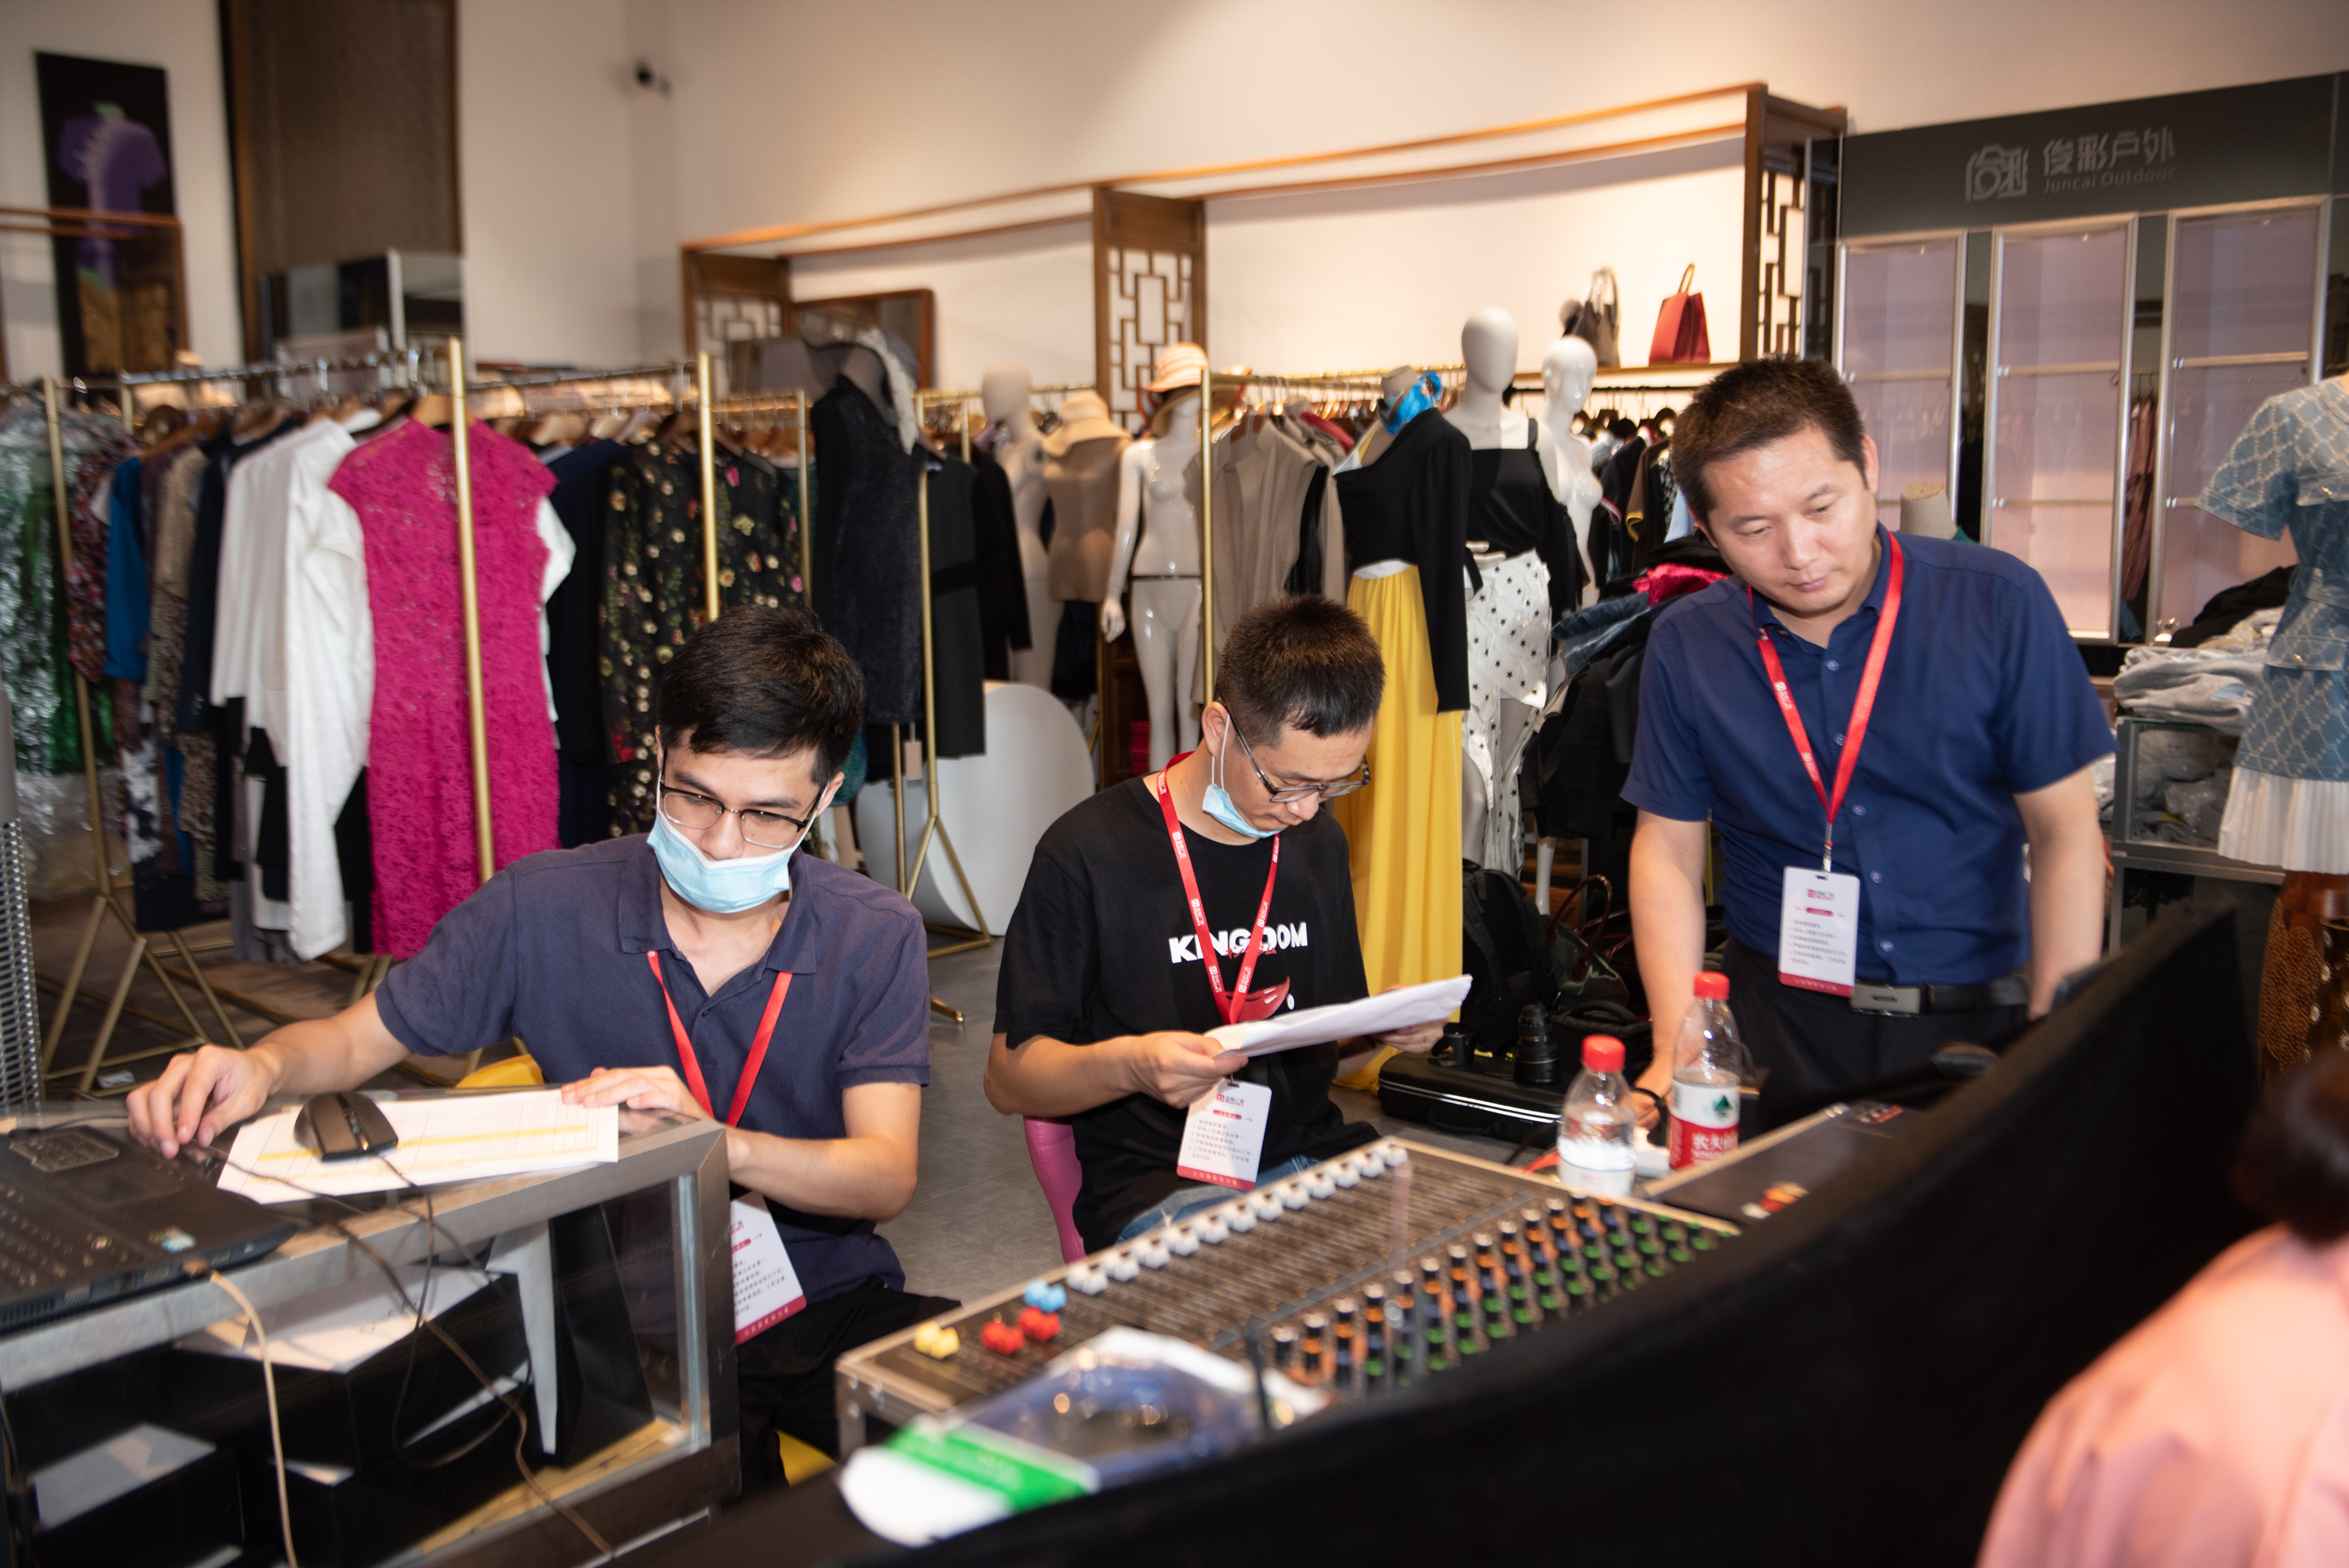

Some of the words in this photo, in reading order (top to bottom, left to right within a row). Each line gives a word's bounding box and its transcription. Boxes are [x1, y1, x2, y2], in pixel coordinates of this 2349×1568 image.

[2043, 126, 2175, 177] 俊彩户外
[2043, 173, 2096, 195] Juncai
[2101, 165, 2175, 189] Outdoor
[1169, 921, 1308, 964] KINGDOM
